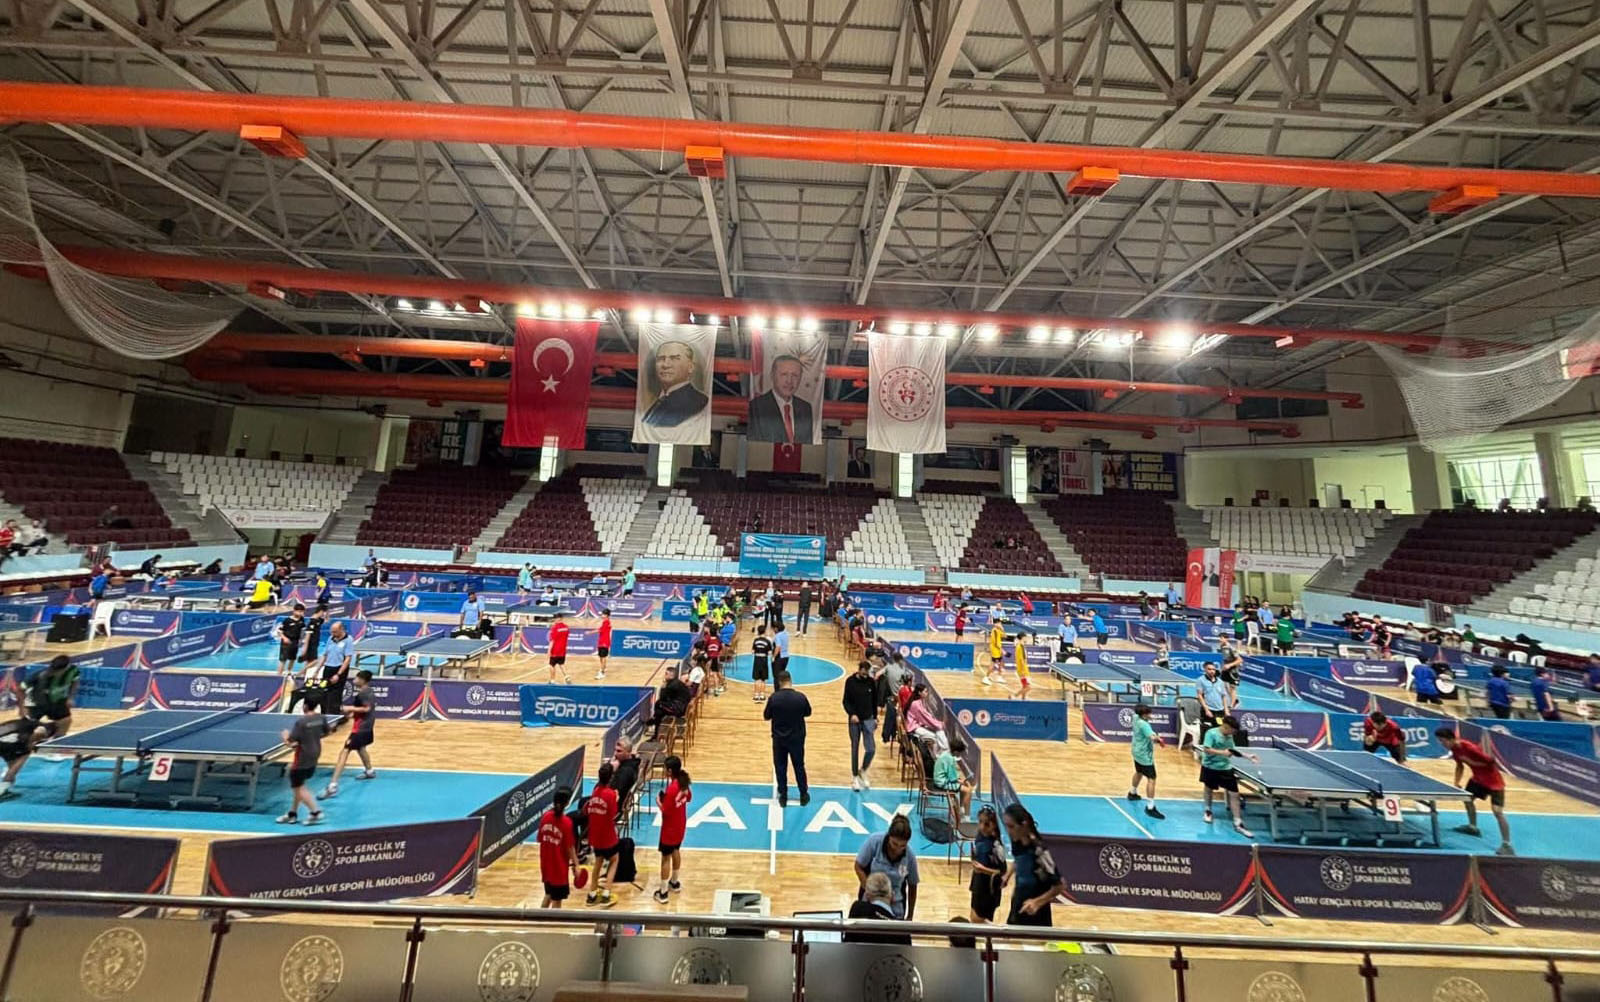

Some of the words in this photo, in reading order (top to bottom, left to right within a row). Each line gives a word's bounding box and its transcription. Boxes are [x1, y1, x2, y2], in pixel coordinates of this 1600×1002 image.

[622, 638, 680, 650] SPORTOTO
[409, 655, 417, 665] 6
[1142, 683, 1152, 693] 10
[535, 701, 619, 721] SPORTOTO
[155, 757, 169, 775] 5
[1385, 799, 1398, 816] 9
[640, 796, 915, 834] ATAY
[336, 846, 352, 855] T.C.
[355, 841, 392, 854] GENÇLİK
[394, 841, 407, 849] VE
[334, 855, 358, 866] SPOR
[360, 850, 405, 863] BAKANLIĞI
[1133, 853, 1146, 862] T.C.
[1147, 853, 1180, 865] GENÇLİK
[1181, 856, 1191, 865] VE
[1133, 863, 1152, 872] SPOR
[1153, 864, 1191, 874] BAKANLIĞI
[1354, 865, 1366, 874] T.C.
[1367, 865, 1400, 876] GENÇLİK
[1401, 867, 1409, 876] VE
[282, 884, 326, 898] GENÇLİK
[326, 883, 338, 893] VE
[339, 881, 364, 892] SPOR
[366, 879, 374, 888] İL
[376, 871, 435, 887] MÜDÜRLÜĞÜ
[1354, 875, 1373, 883] SPOR
[1071, 883, 1096, 893] HATAY
[1096, 885, 1129, 898] GENÇLİK
[1129, 888, 1141, 896] VE
[1142, 888, 1162, 898] SPOR
[1163, 888, 1170, 898] İL
[1171, 889, 1221, 901] MÜDÜRLÜĞÜ
[1294, 896, 1318, 905] HATAY
[1319, 896, 1351, 908] GENÇLİK
[1352, 899, 1362, 907] VE
[1363, 899, 1383, 908] SPOR
